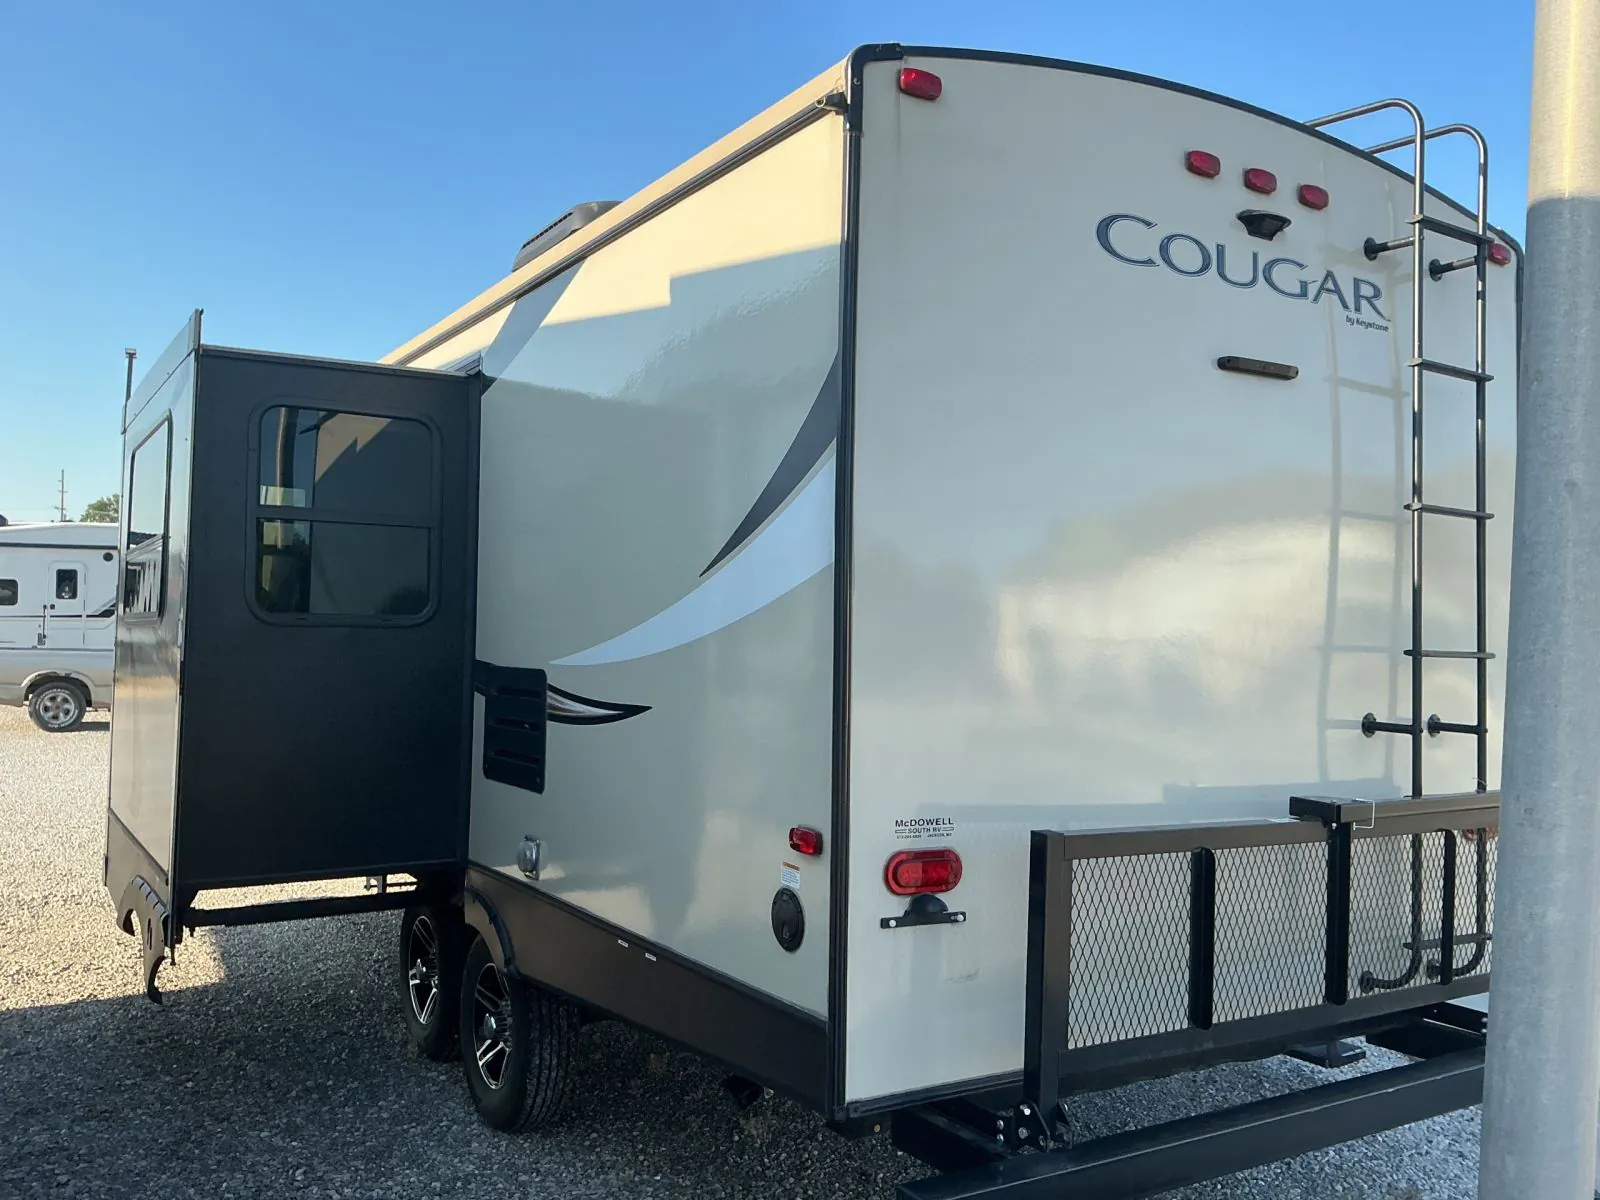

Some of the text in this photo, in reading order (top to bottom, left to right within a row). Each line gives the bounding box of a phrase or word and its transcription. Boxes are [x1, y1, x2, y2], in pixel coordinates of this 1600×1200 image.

[1096, 213, 1391, 322] COUGAR
[1346, 314, 1389, 332] by Keystone
[895, 817, 954, 827] McDOWELL
